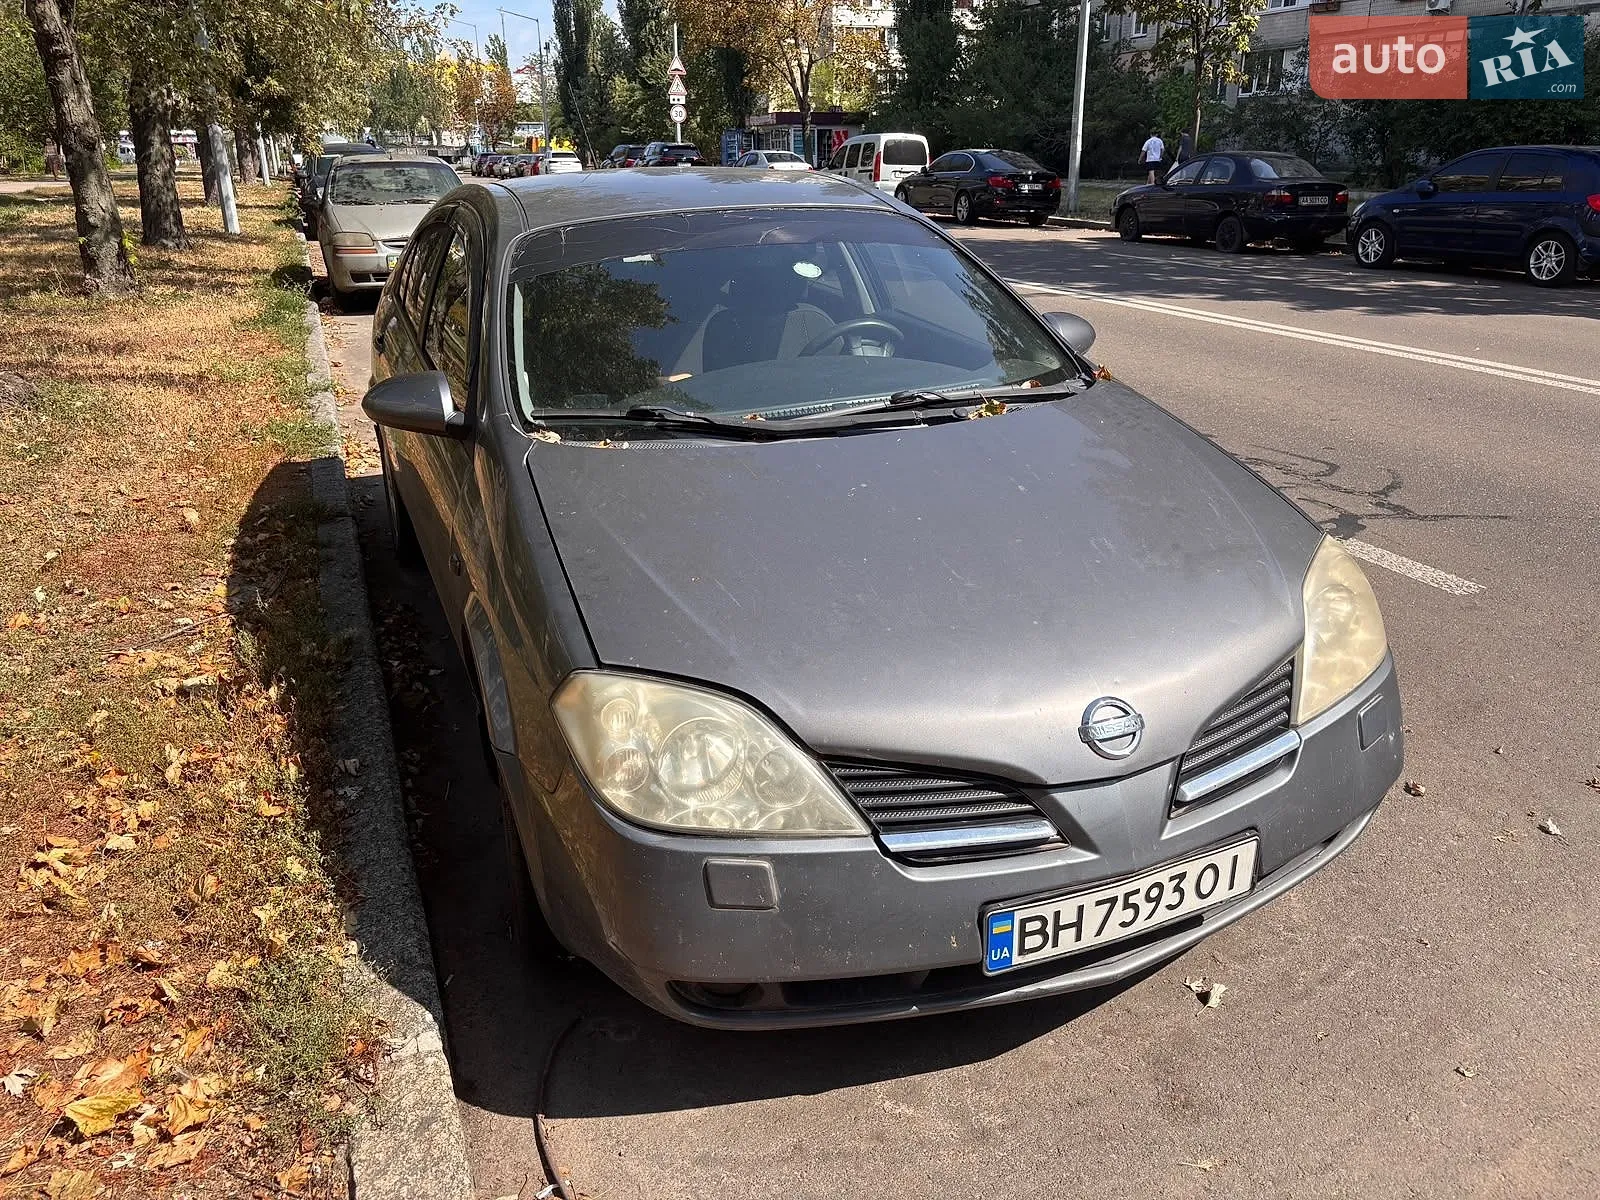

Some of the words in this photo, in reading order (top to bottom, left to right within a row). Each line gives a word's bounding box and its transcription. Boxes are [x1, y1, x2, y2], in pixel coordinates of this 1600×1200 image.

[673, 110, 684, 118] 30
[1088, 718, 1138, 740] NISSAN
[1017, 904, 1084, 956] BH
[1094, 871, 1188, 938] 7593
[991, 946, 1010, 961] UA
